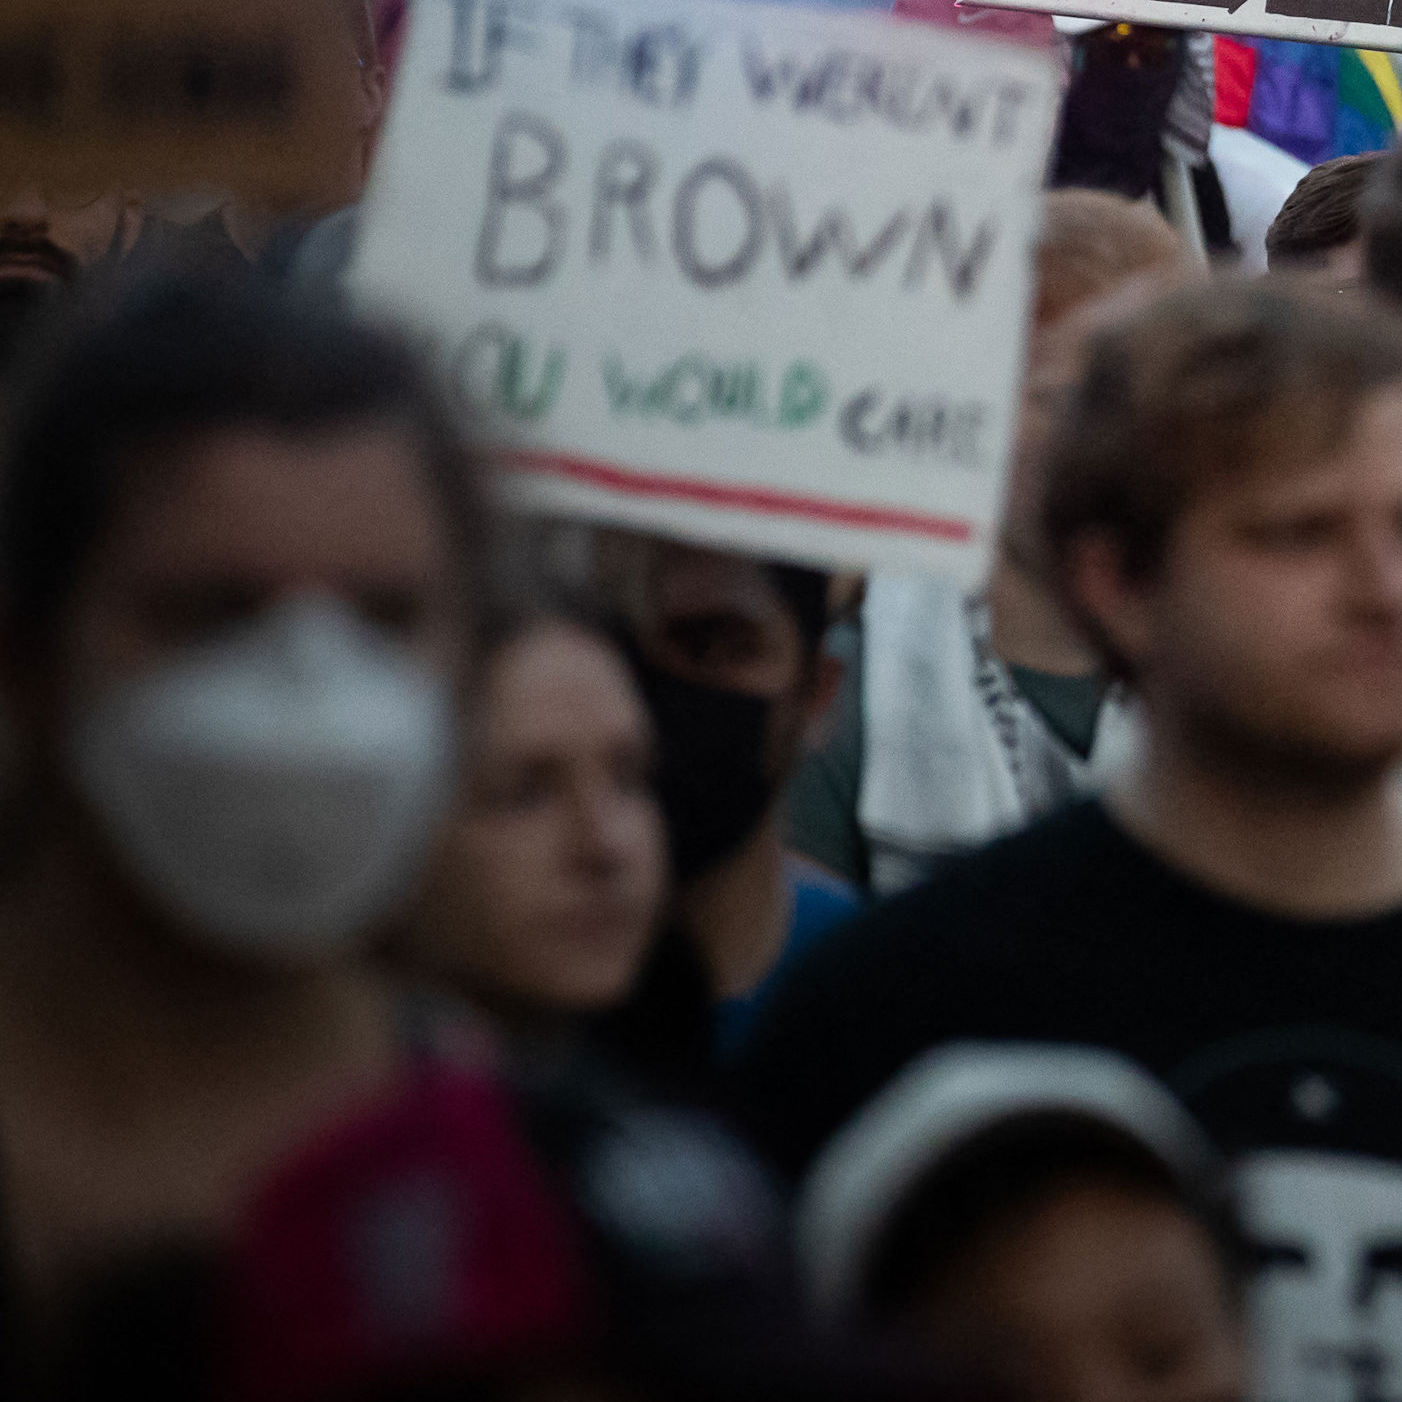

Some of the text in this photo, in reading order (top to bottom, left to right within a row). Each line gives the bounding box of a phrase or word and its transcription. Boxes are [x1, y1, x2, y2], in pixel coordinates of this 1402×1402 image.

[471, 105, 1001, 308] BROWN
[447, 319, 567, 421] OU
[597, 345, 831, 429] WOULD
